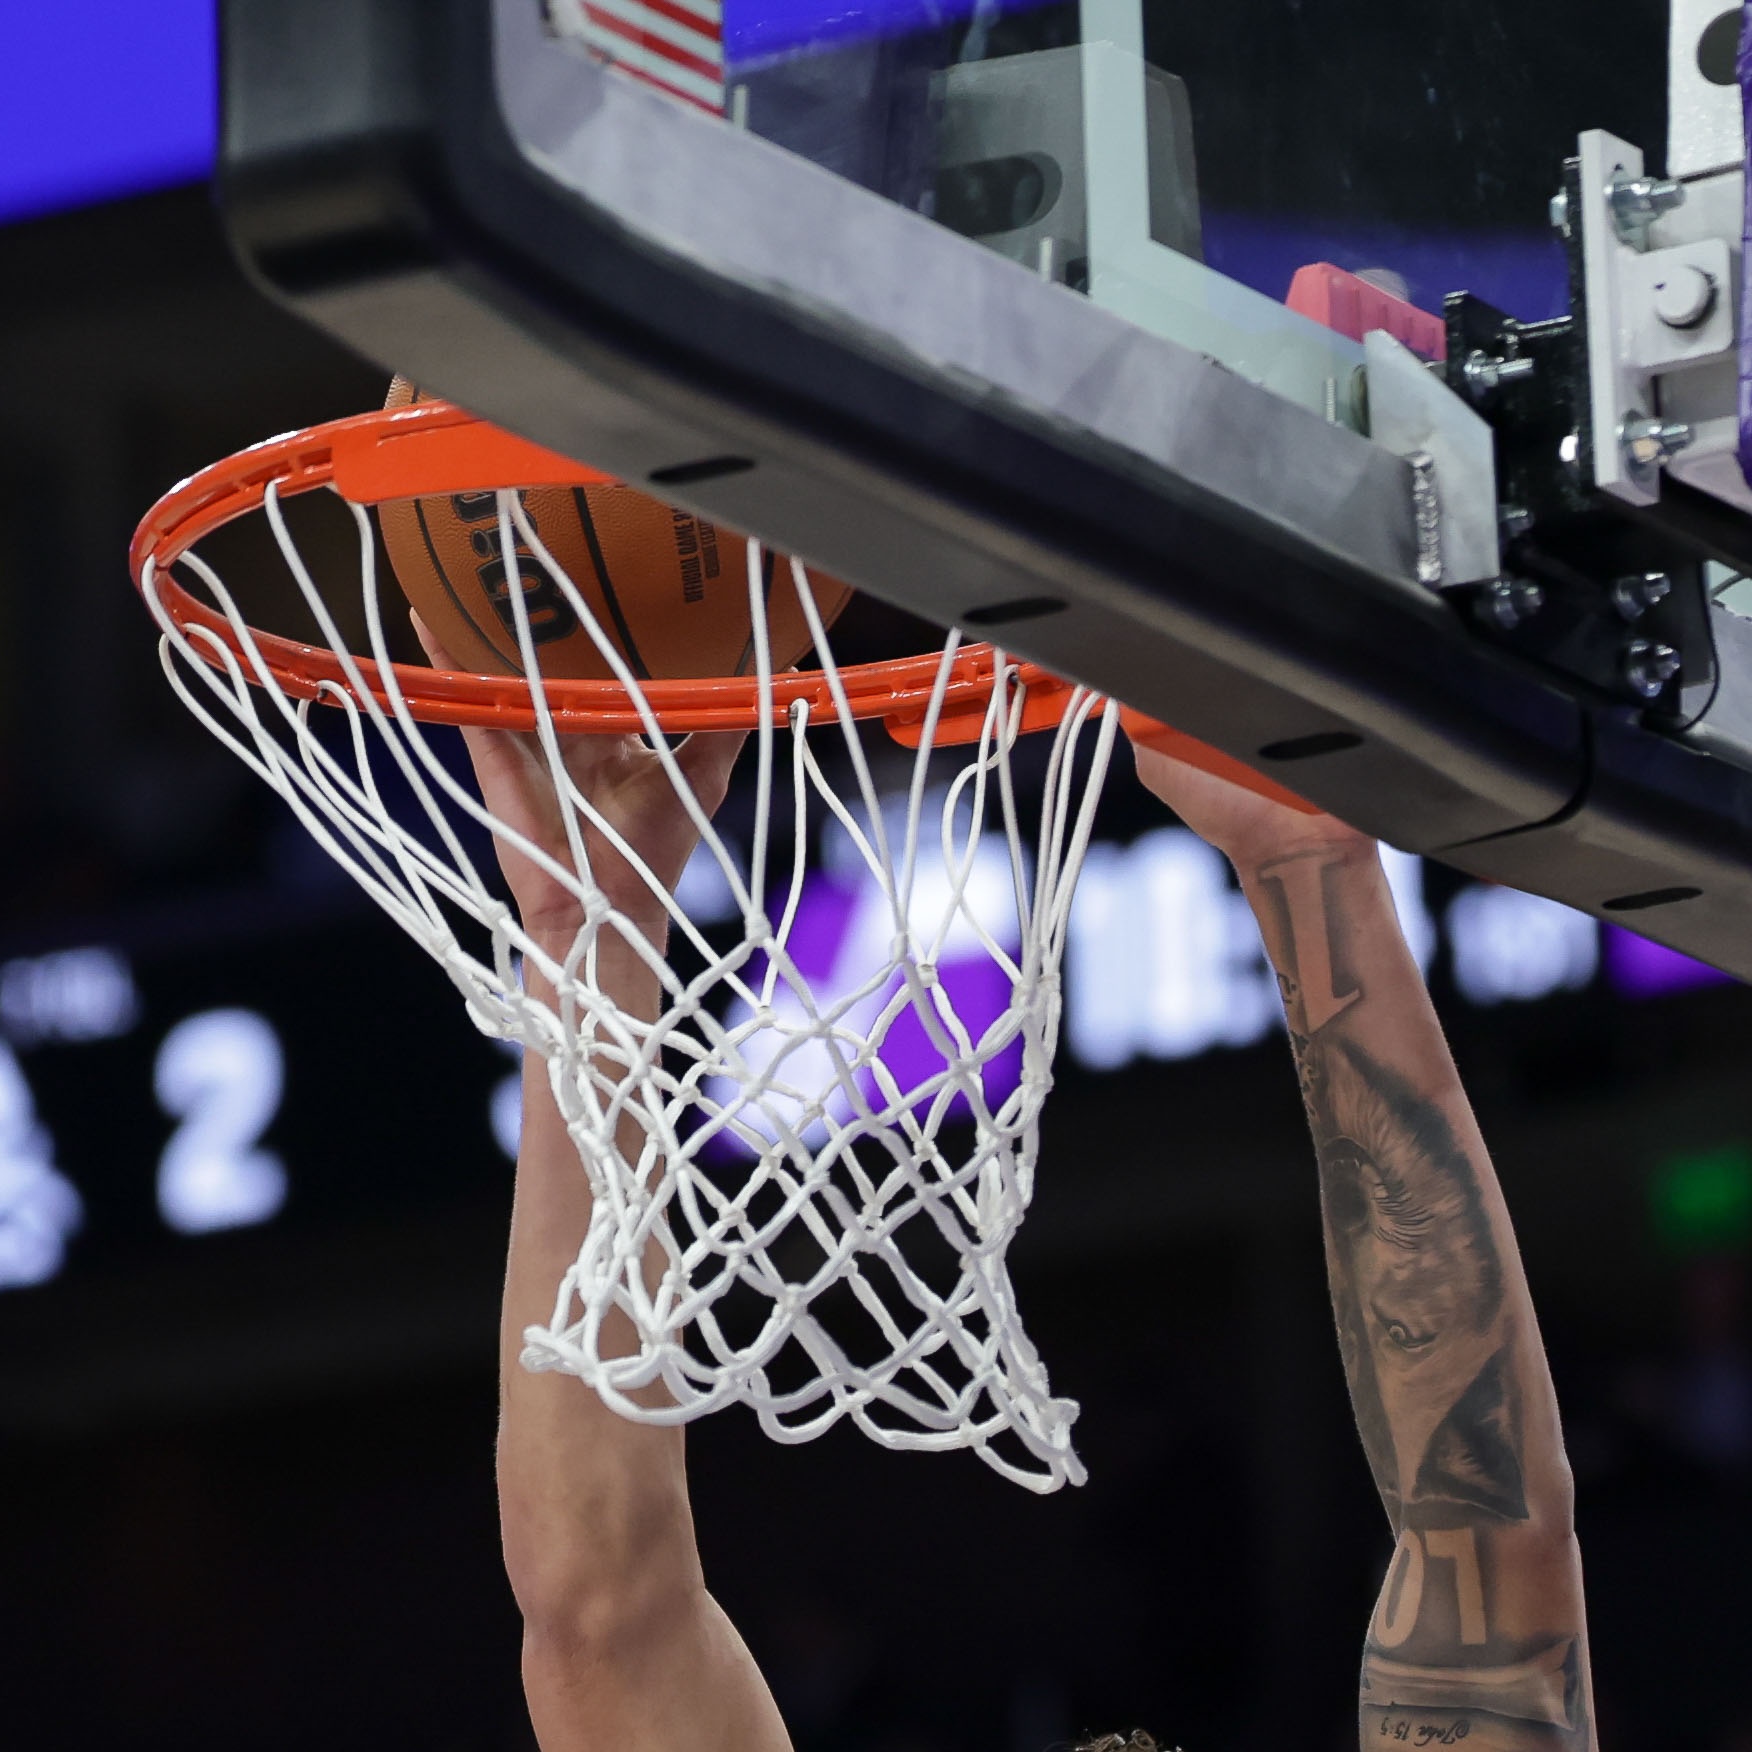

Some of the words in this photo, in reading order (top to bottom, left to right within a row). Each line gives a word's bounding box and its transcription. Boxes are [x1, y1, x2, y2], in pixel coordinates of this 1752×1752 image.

[154, 1008, 288, 1235] 2
[1379, 1717, 1411, 1741] 15:5
[1413, 1719, 1471, 1748] John
